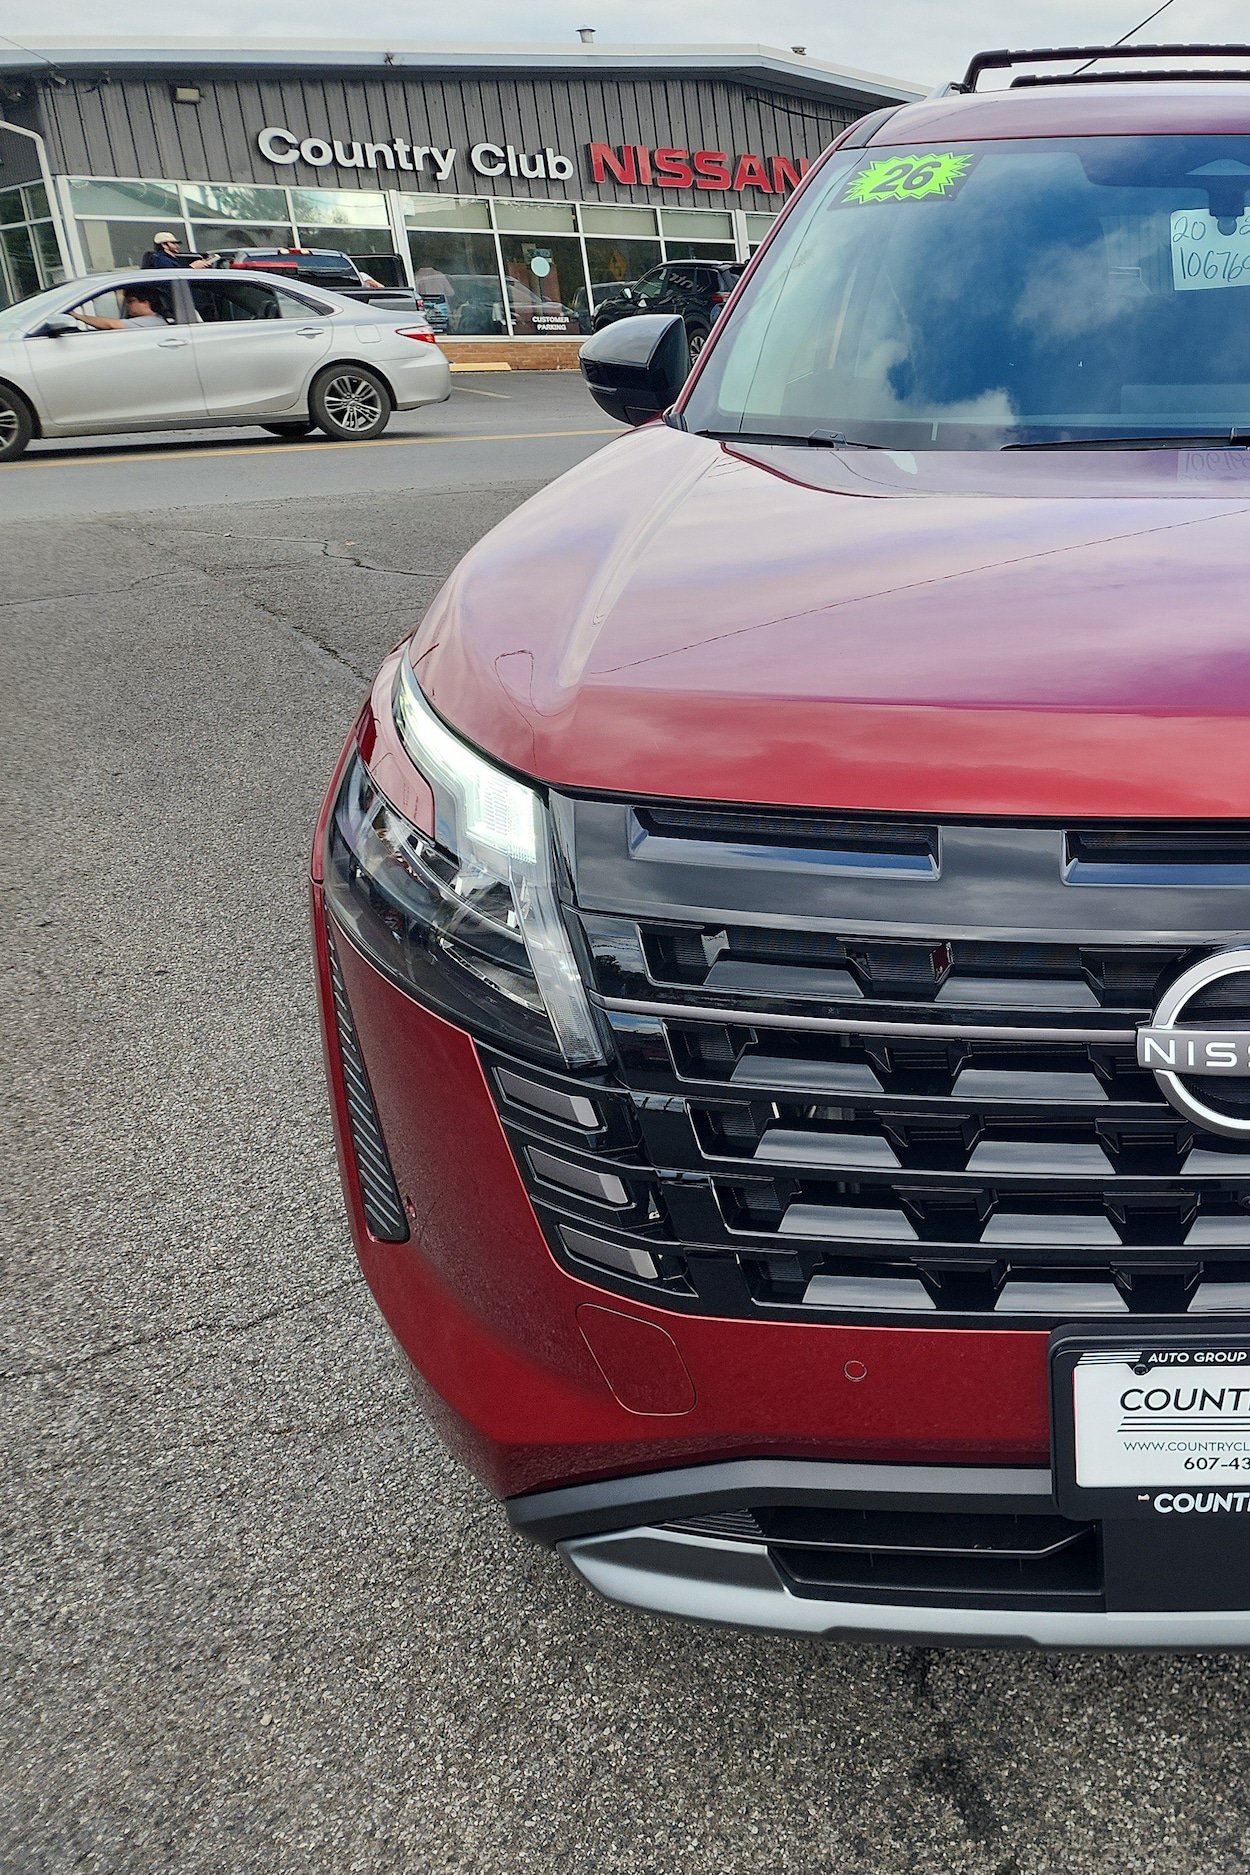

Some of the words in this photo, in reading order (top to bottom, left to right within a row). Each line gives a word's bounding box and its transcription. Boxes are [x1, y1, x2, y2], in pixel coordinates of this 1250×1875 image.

[258, 127, 456, 180] Country
[471, 143, 574, 180] Club
[589, 143, 810, 193] NISSAN
[869, 161, 942, 193] 26
[1148, 1352, 1190, 1363] AUTO
[1194, 1351, 1248, 1363] GROUP
